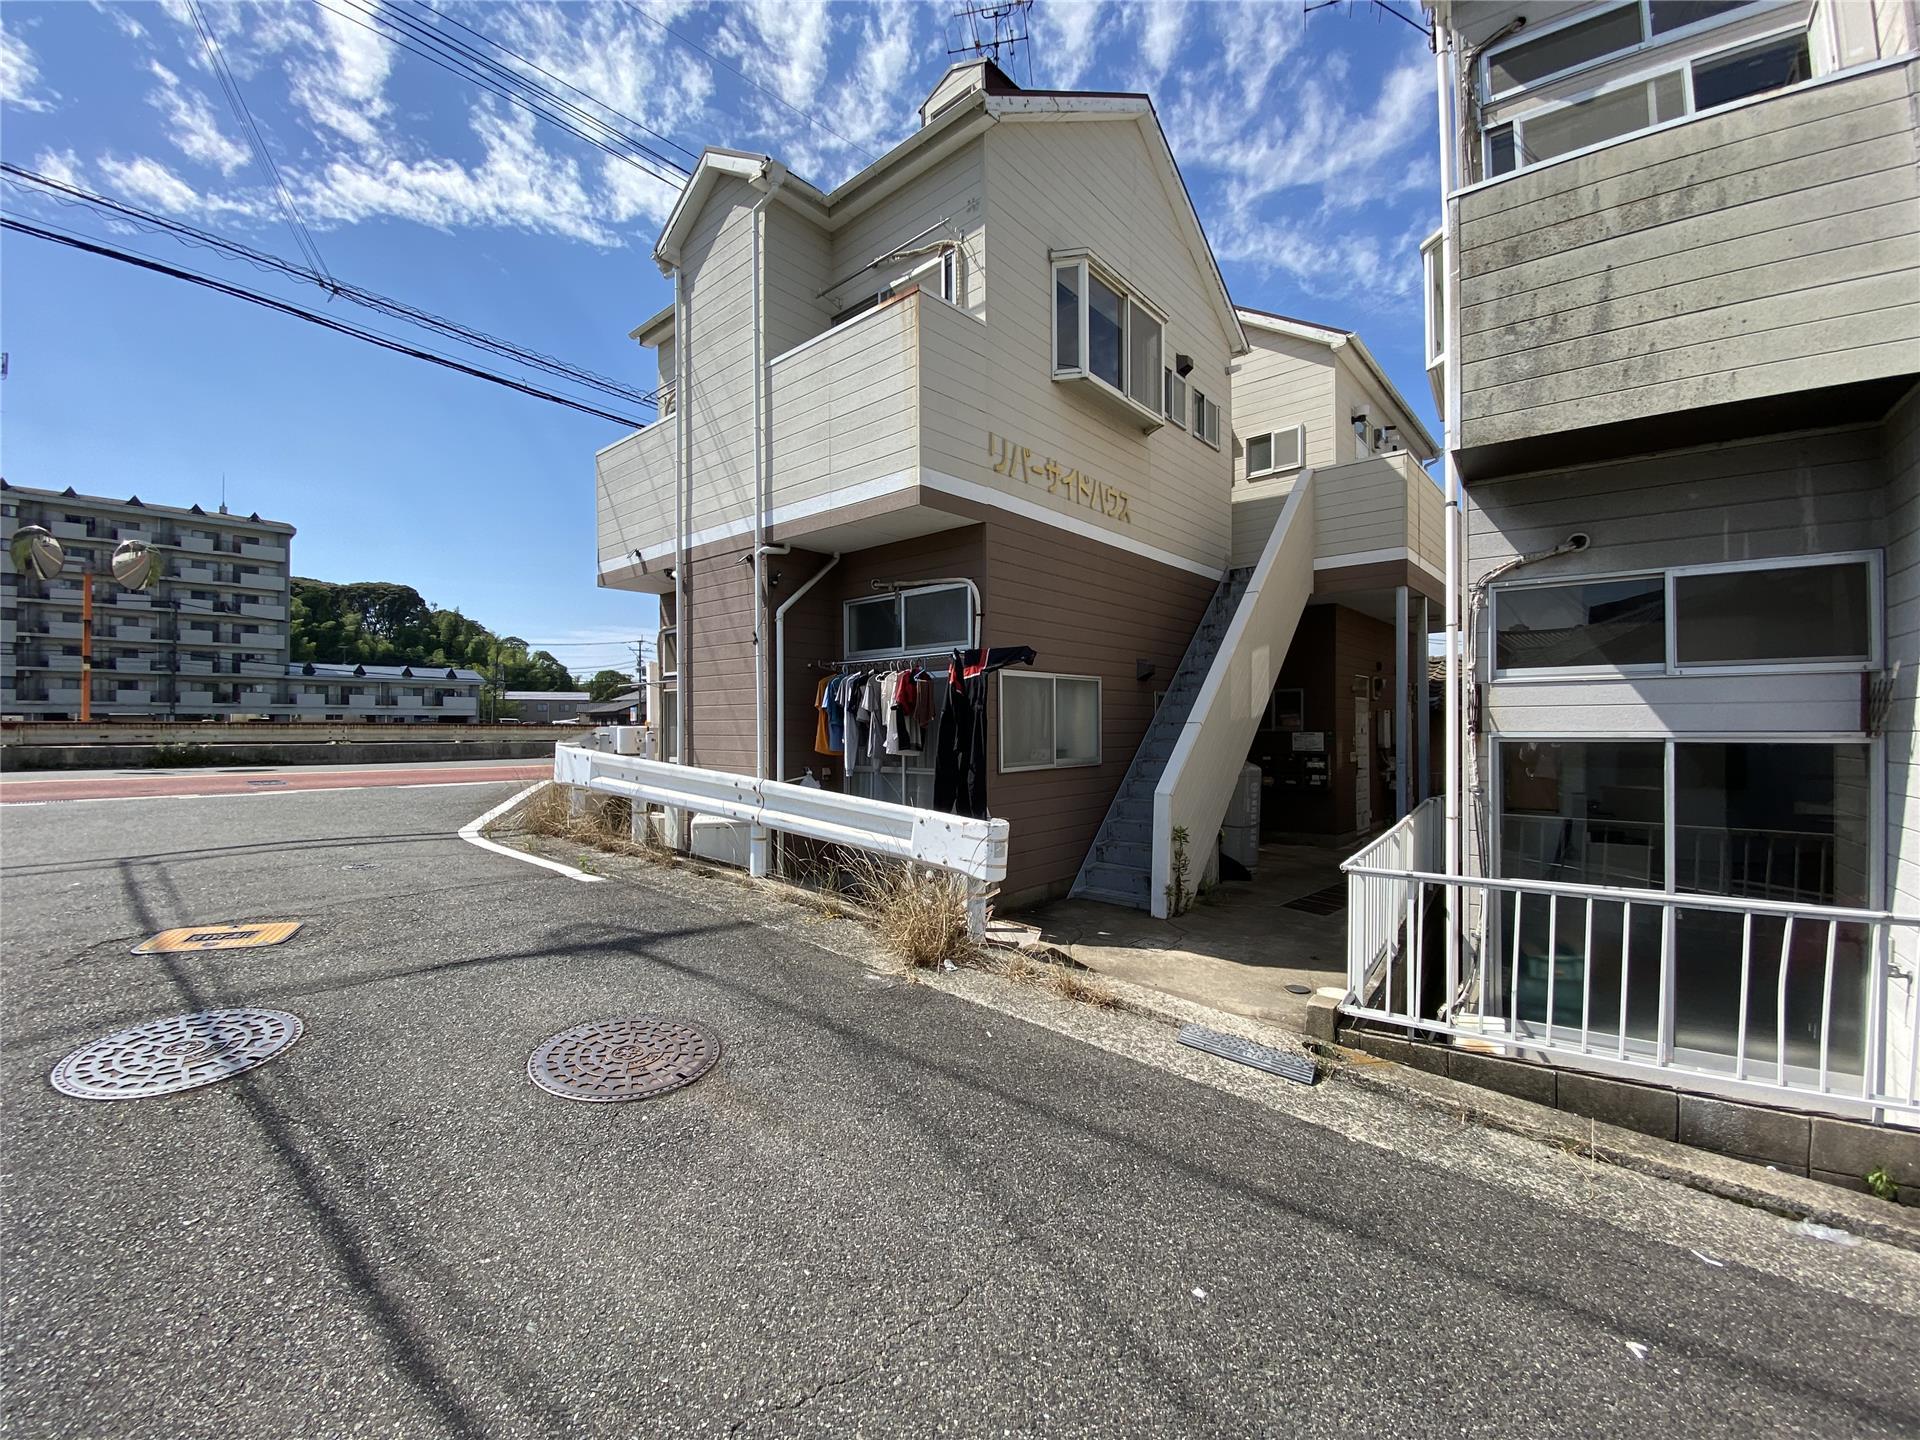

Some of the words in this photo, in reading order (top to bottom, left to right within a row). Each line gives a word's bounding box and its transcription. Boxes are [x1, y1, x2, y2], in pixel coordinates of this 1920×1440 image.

[988, 431, 1131, 524] リバーサイドハウス
